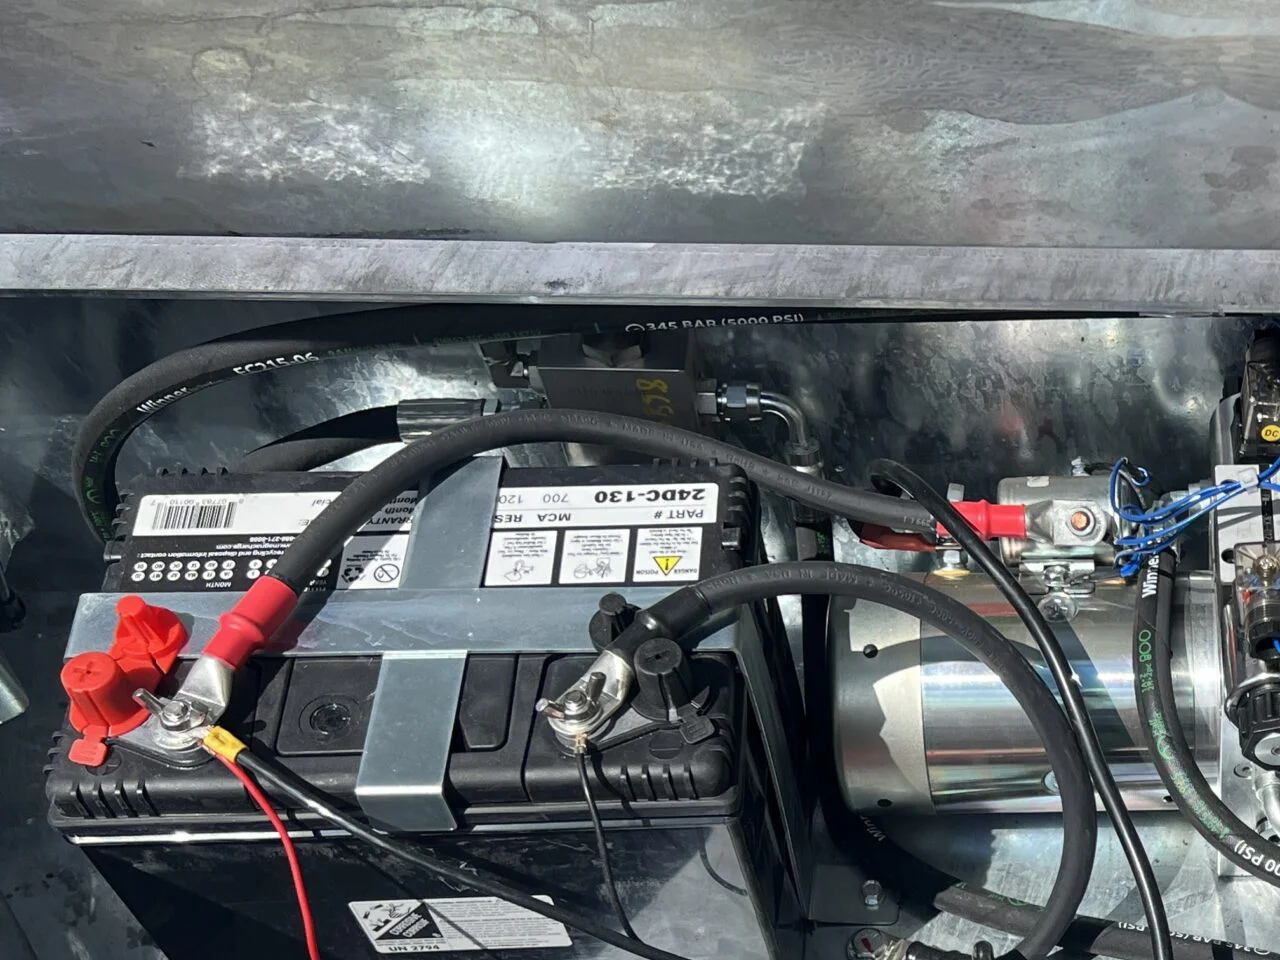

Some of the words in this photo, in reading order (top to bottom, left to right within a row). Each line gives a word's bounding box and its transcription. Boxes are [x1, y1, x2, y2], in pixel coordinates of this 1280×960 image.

[1265, 429, 1280, 438] DC
[499, 493, 524, 504] 120
[542, 493, 569, 504] 700
[594, 488, 706, 504] 24DC-130
[537, 512, 571, 522] MCA
[654, 510, 663, 519] #
[666, 509, 704, 519] PART
[1233, 839, 1263, 863] PSI)
